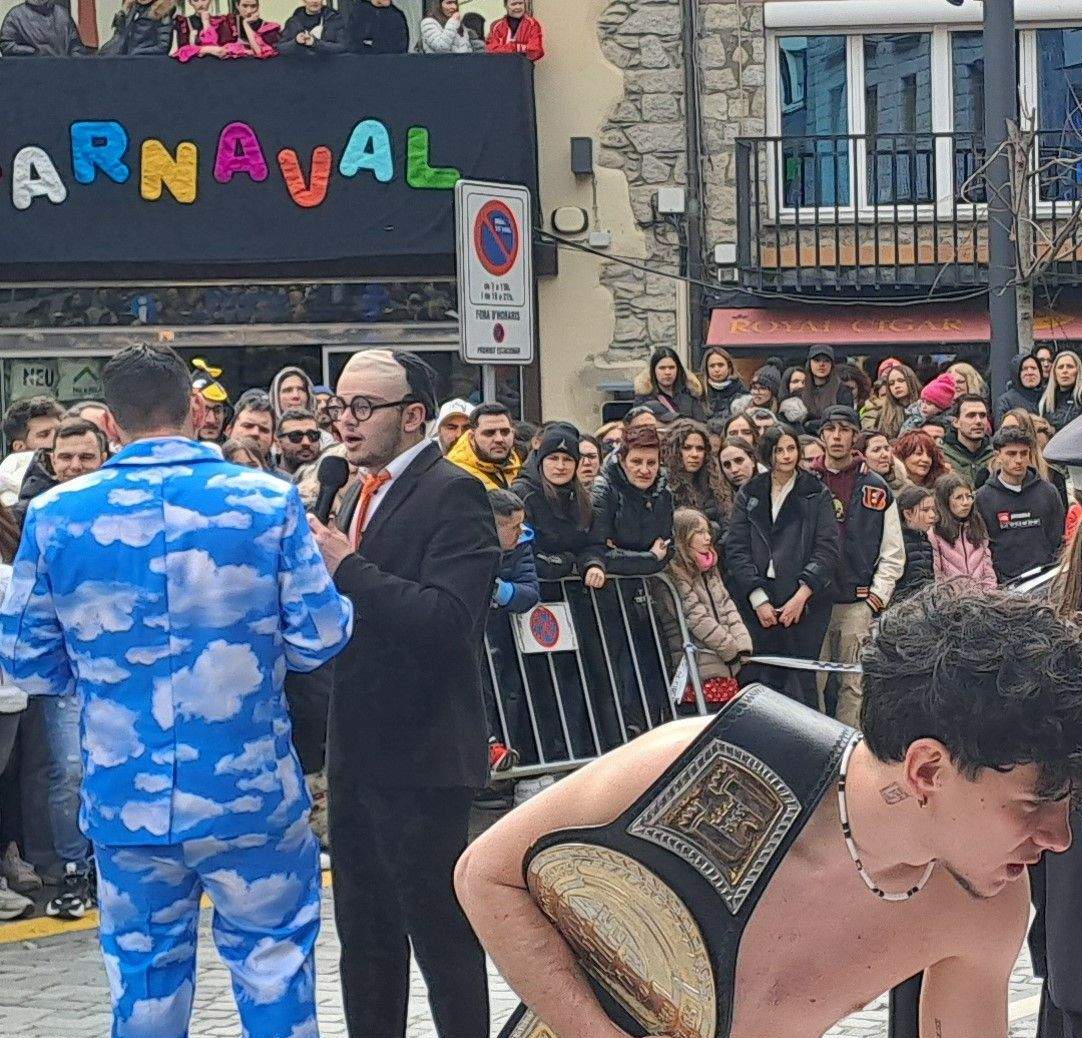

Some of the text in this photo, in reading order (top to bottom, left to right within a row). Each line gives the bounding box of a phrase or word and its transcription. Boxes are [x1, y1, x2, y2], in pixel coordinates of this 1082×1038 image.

[0, 117, 461, 211] ARNAVAL
[730, 317, 965, 334] ROYAL CIGAR
